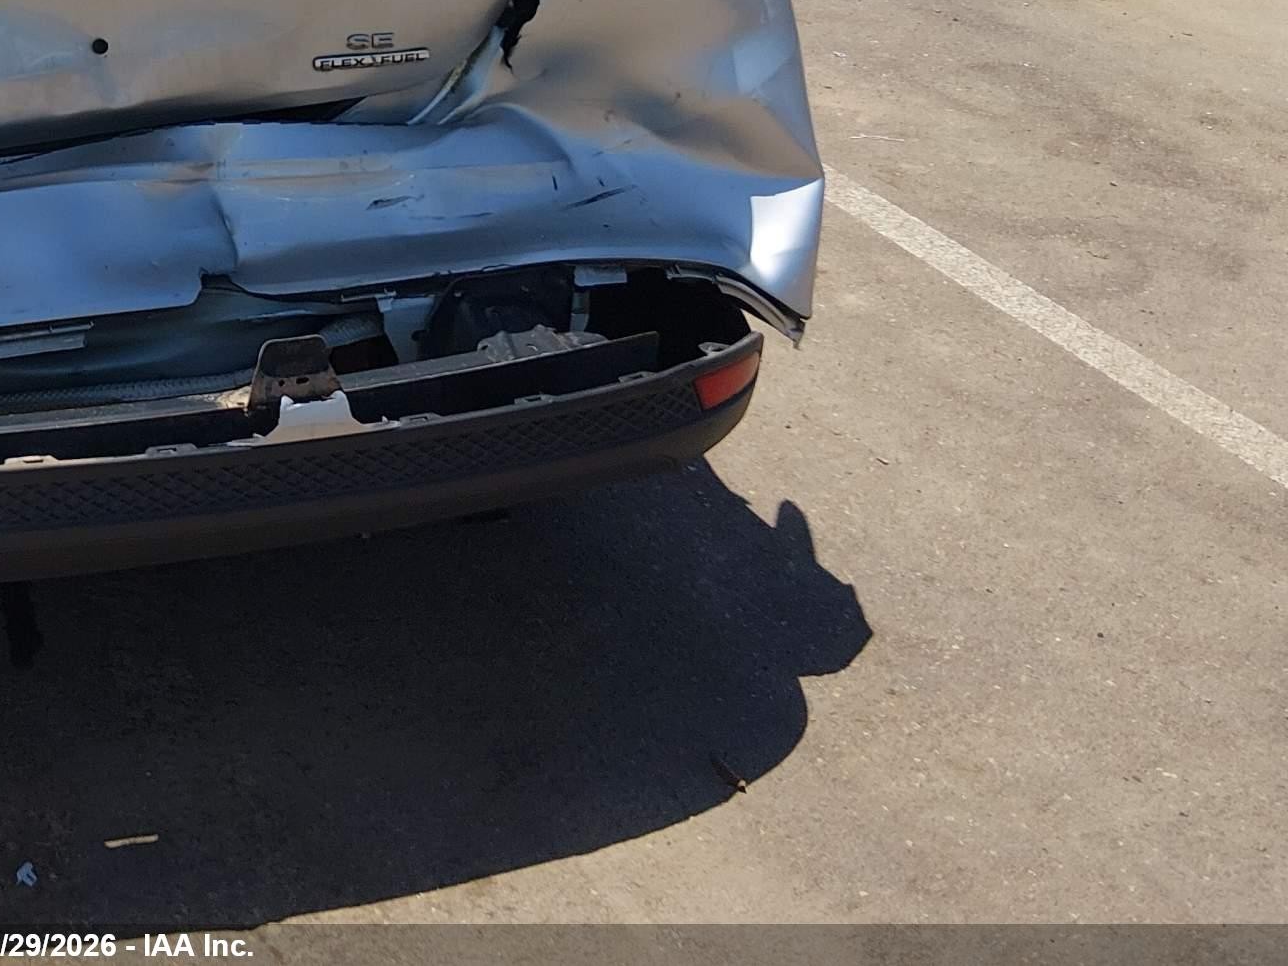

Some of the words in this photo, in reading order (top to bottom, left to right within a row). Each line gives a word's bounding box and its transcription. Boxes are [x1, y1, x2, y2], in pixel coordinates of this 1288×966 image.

[346, 32, 394, 50] SE
[319, 57, 365, 70] FLEX
[380, 51, 428, 65] FUEL
